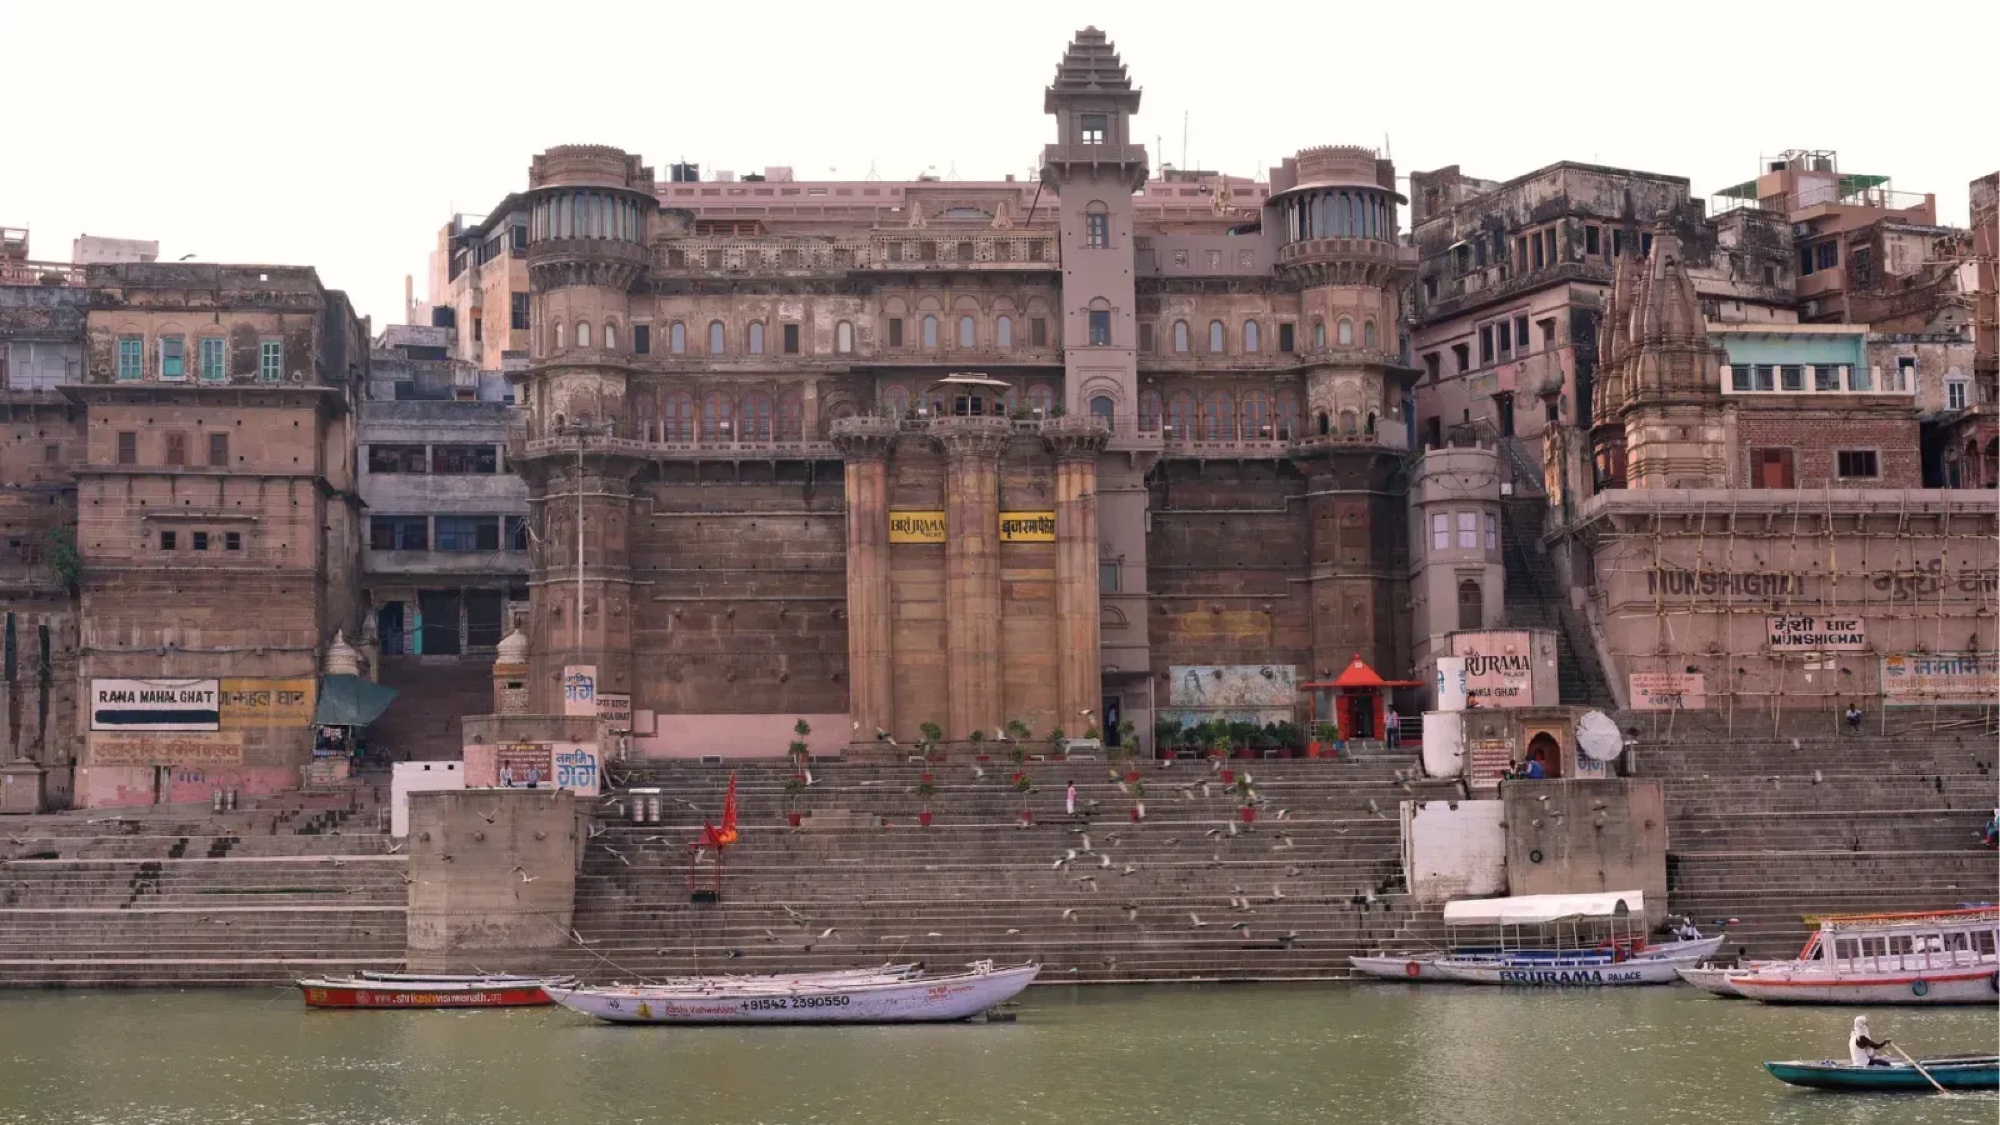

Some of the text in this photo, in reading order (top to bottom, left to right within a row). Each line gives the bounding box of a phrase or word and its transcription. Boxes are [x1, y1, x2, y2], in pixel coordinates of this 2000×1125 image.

[1771, 634, 1864, 645] MUNSHIGHAT
[1464, 651, 1531, 677] RIJRAMA
[99, 690, 214, 703] RANA MAHAL GHAT
[1494, 687, 1520, 696] GHAT
[1608, 972, 1641, 981] PALACE
[741, 1000, 787, 1011] +91542
[792, 996, 850, 1009] 2390550
